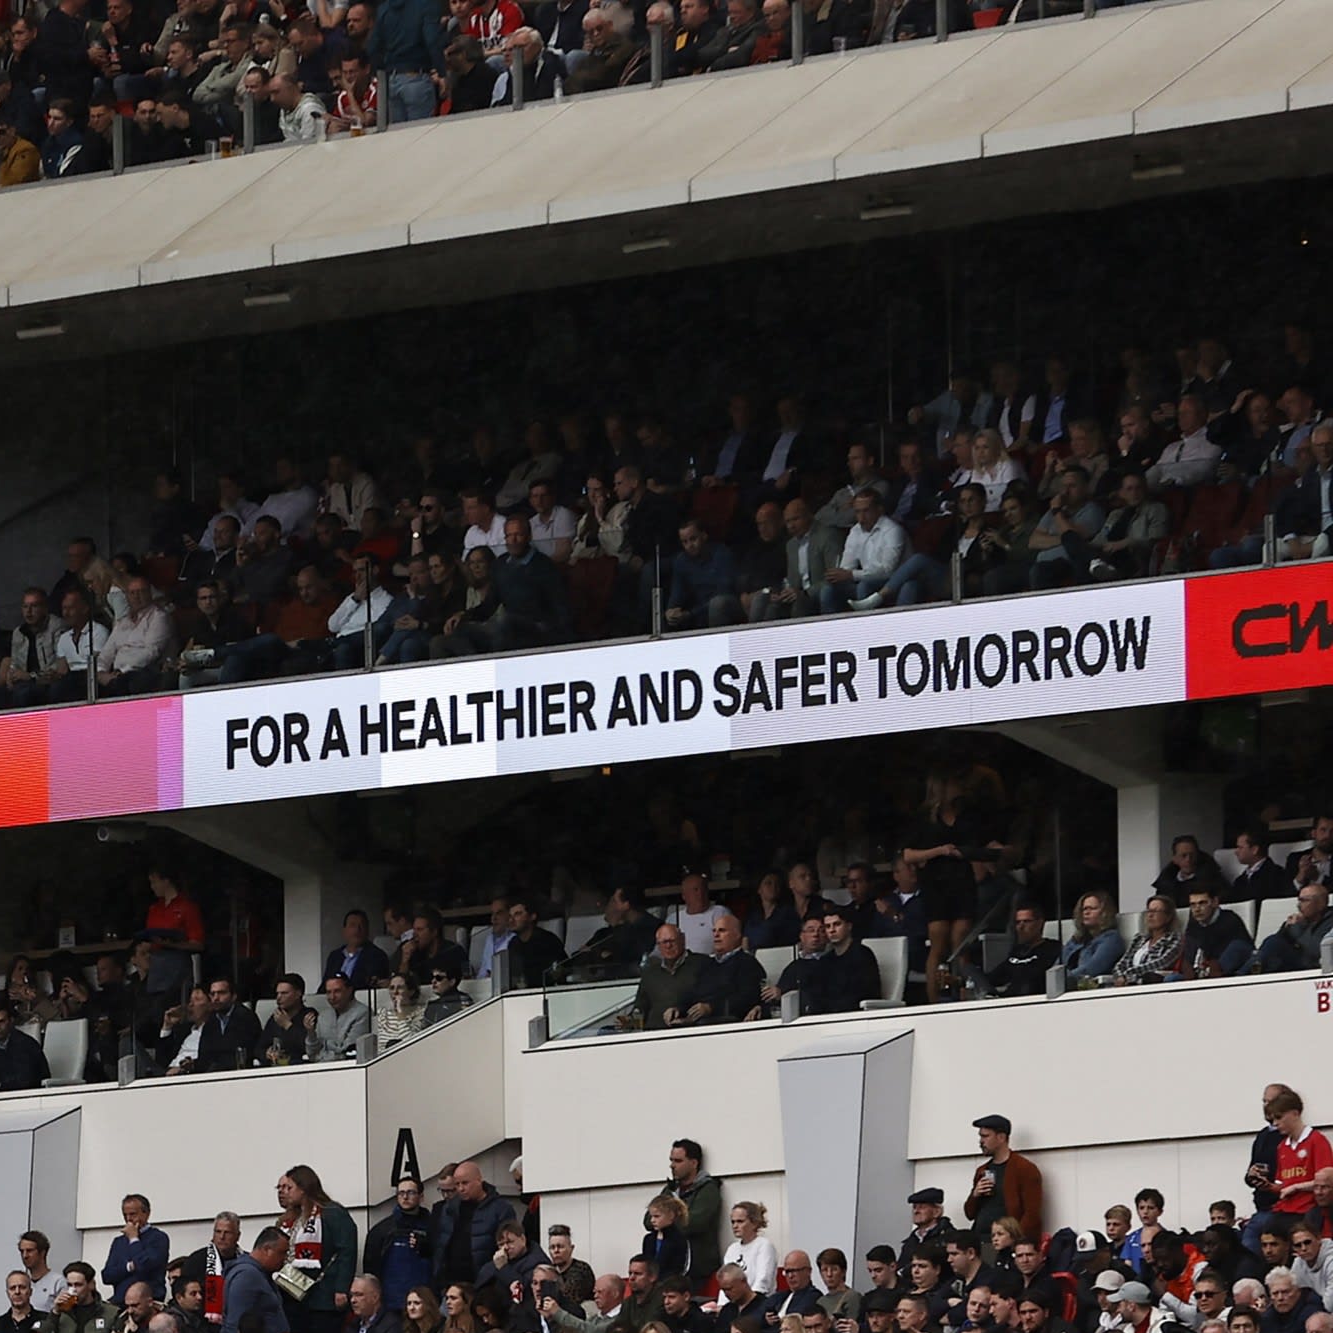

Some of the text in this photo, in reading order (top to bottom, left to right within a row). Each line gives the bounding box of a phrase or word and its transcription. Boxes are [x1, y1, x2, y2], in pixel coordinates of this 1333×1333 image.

[1232, 600, 1333, 659] CW
[226, 616, 1151, 771] FOR A HEALTHIER AND SAFER TOMORROW
[1317, 992, 1331, 1012] B
[391, 1128, 422, 1187] A
